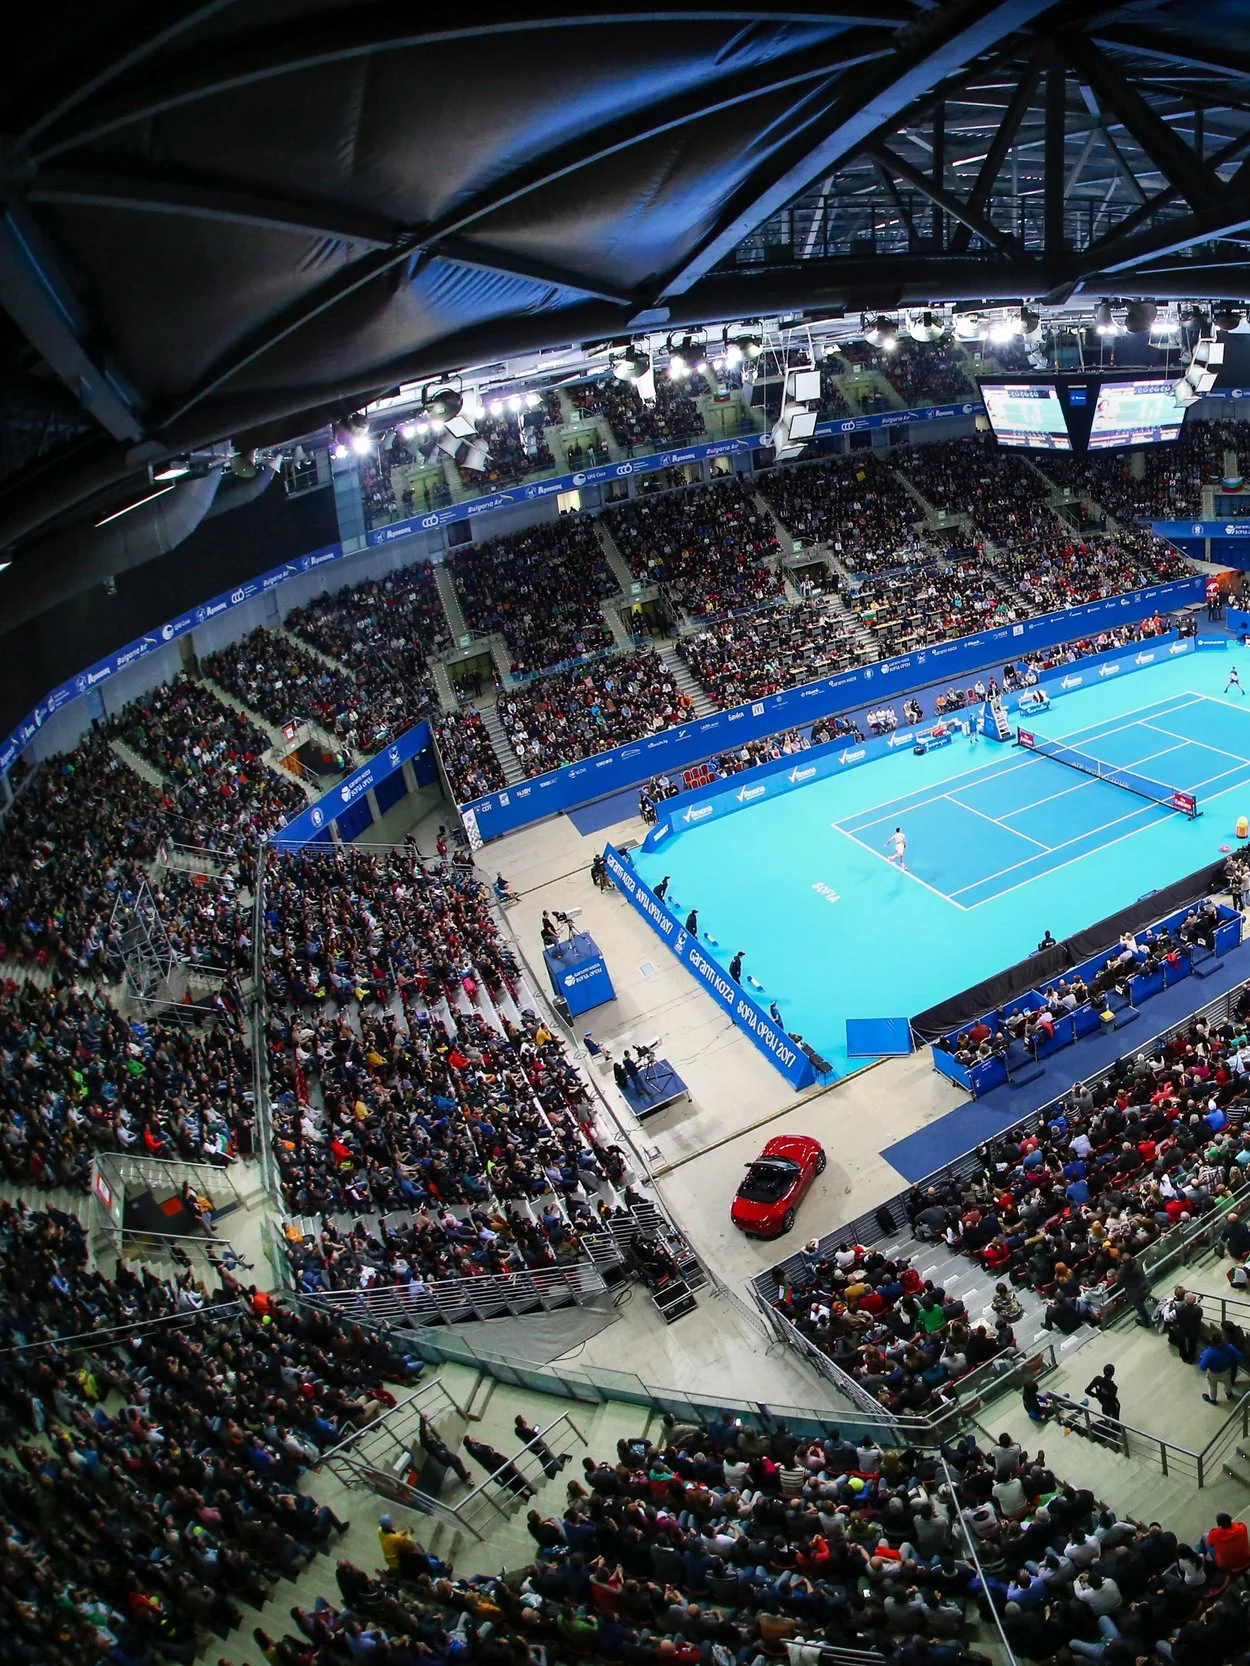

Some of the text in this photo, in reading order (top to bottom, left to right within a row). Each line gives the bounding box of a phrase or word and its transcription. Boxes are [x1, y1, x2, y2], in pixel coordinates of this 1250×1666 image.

[635, 888, 650, 912] SOFIA
[659, 915, 674, 935] 2017
[689, 948, 716, 984] Garanti
[736, 999, 757, 1031] SOFIA
[756, 1021, 779, 1052] OPEN
[775, 1042, 797, 1068] 2017
